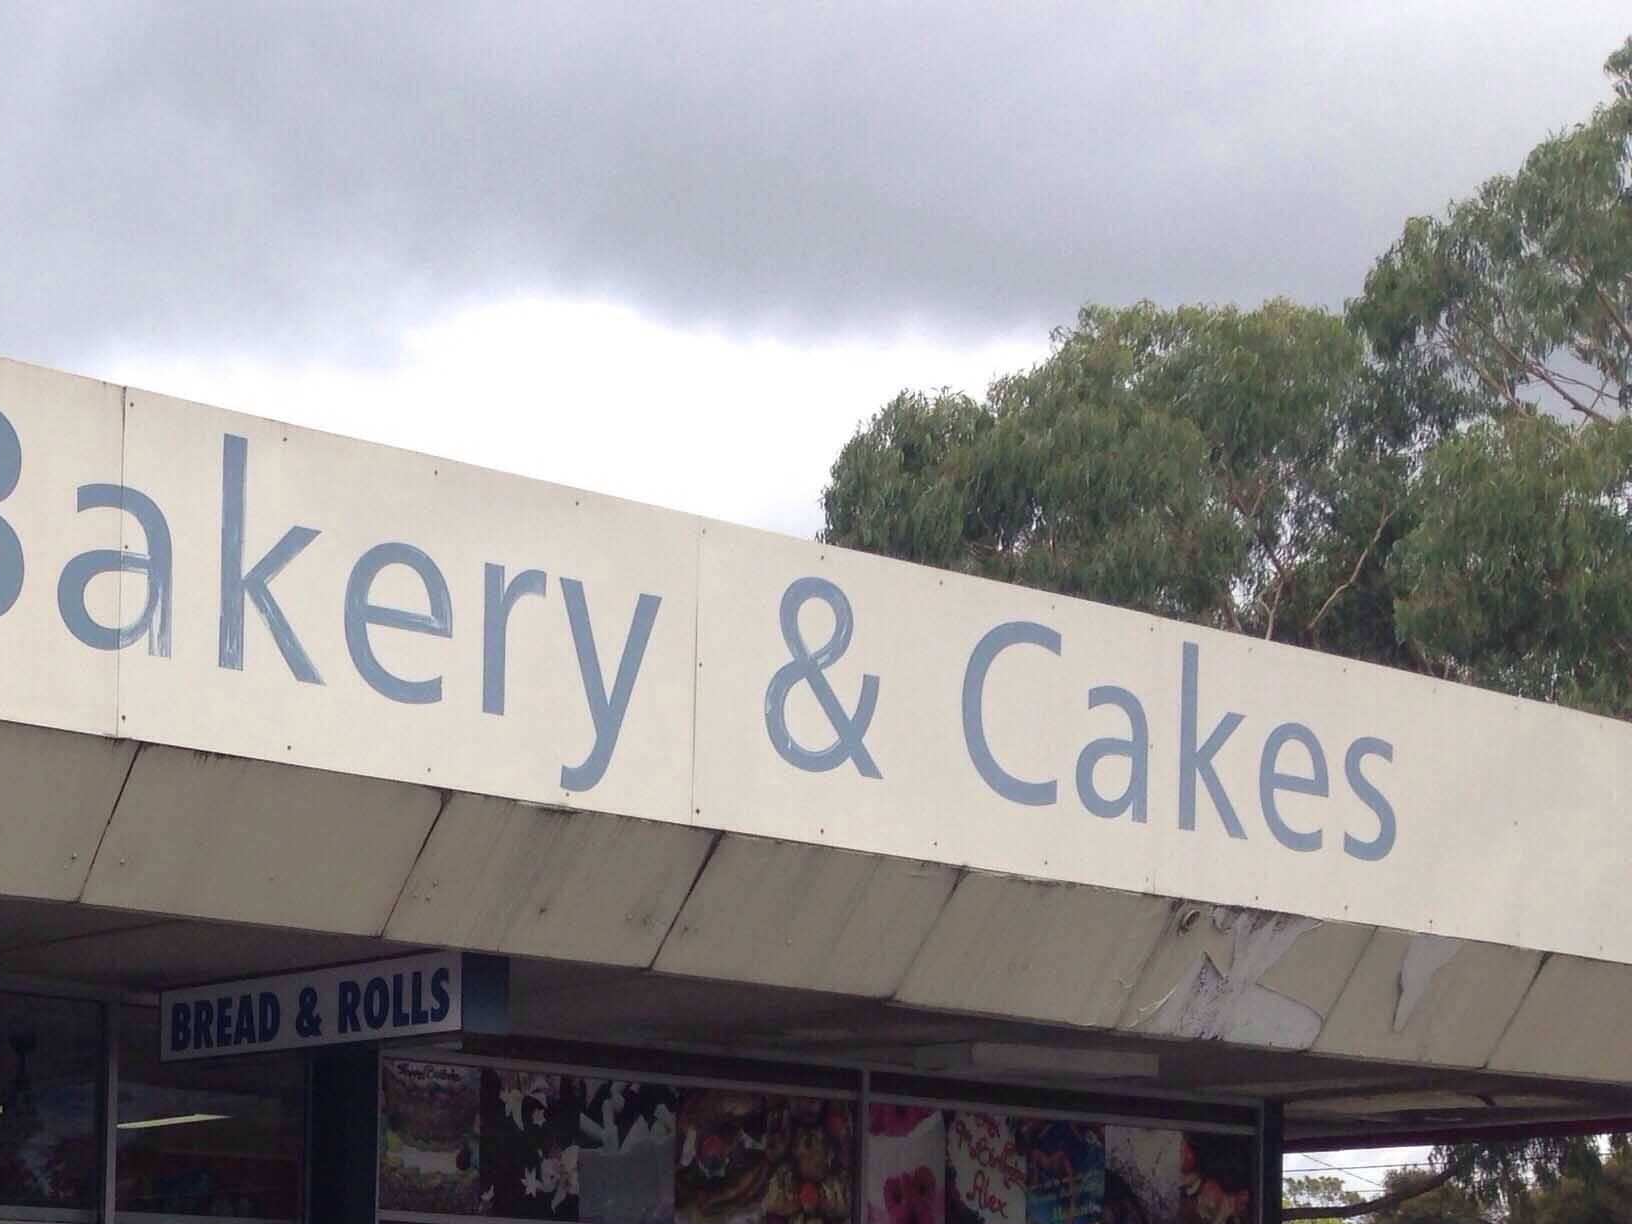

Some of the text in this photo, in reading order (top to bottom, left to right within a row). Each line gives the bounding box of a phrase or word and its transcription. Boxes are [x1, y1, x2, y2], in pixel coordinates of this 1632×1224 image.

[764, 576, 883, 780] &
[961, 620, 1399, 862] Cakes
[171, 968, 449, 1051] BREAD & ROLLS
